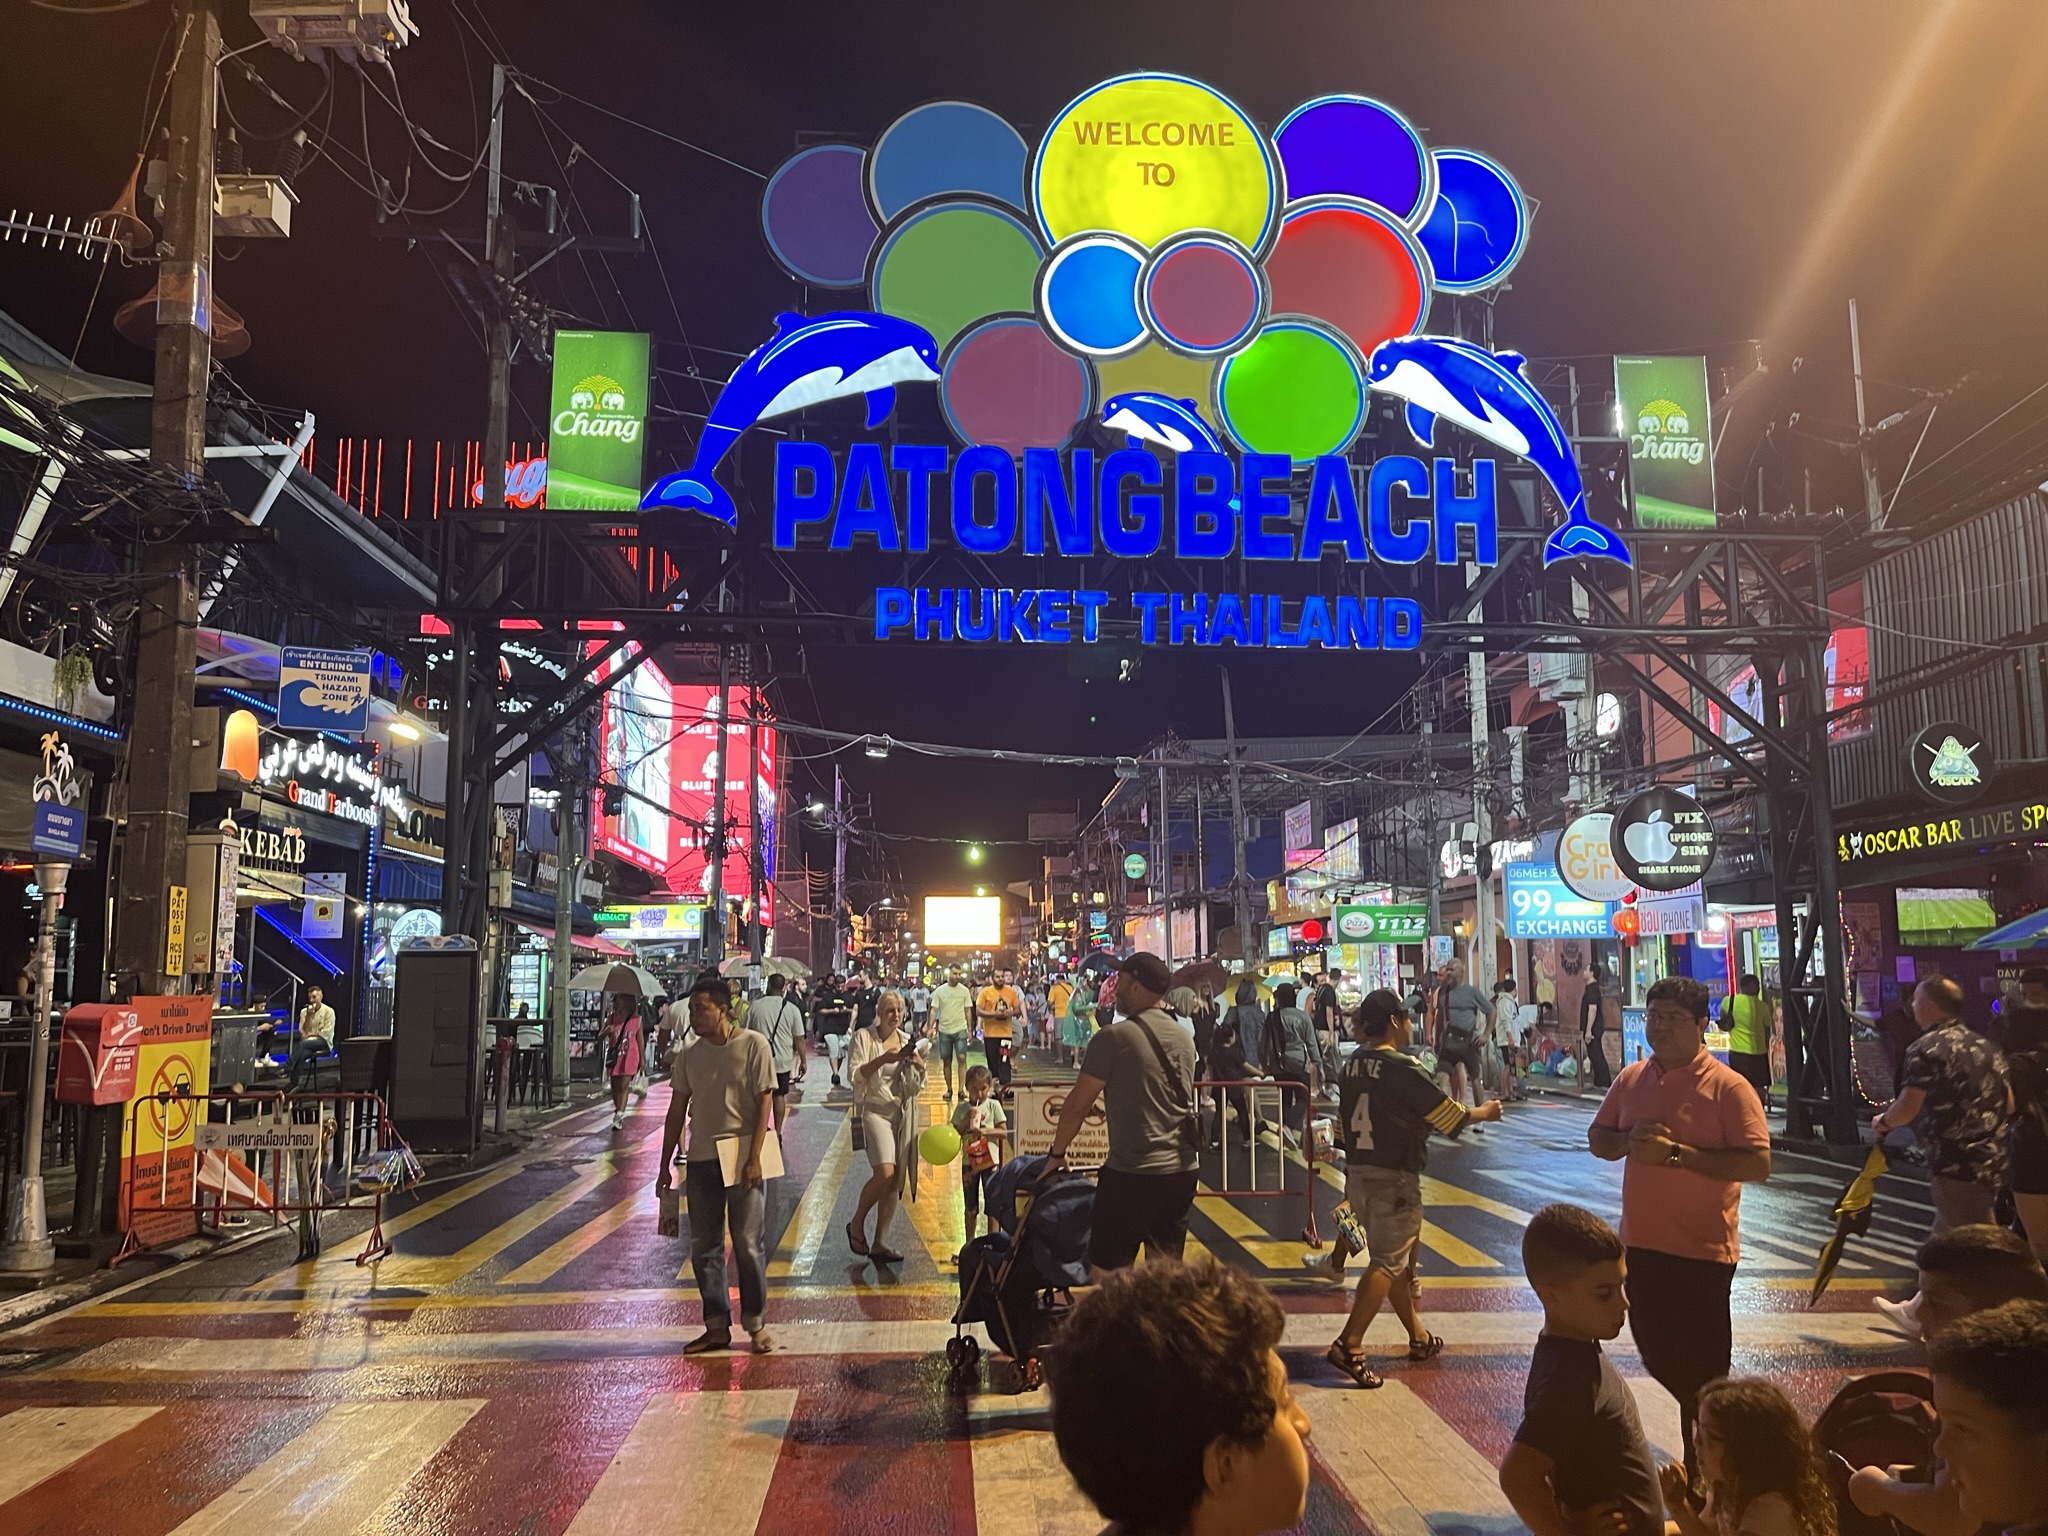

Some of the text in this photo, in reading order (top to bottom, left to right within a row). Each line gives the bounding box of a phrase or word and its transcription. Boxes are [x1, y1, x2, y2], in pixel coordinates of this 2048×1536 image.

[1073, 121, 1235, 146] WELCOME
[1136, 162, 1176, 187] TO
[553, 410, 641, 443] Chang
[773, 441, 1499, 568] PATONG BEACH
[874, 587, 1423, 651] PHUKET THAILAND
[299, 660, 353, 671] ENTERING
[314, 673, 358, 683] TSUNAMI
[322, 684, 362, 693] HAZARD
[321, 693, 349, 702] ZONE
[1937, 775, 1974, 787] OSCAR
[288, 780, 378, 826] Grand Tarboosh
[1673, 812, 1704, 824] FIX
[1864, 804, 2048, 856] OSCAR BAR LIVE SP
[1670, 832, 1713, 842] IPHONE
[240, 827, 306, 864] KEBAB
[1566, 834, 1610, 858] Cra
[1680, 845, 1709, 856] SIM
[1638, 864, 1702, 874] SHARK PHONE
[171, 898, 185, 908] PAT
[1512, 889, 1552, 916] 99
[1346, 919, 1368, 927] PIZZA
[1377, 917, 1426, 930] 1112
[1516, 919, 1607, 935] EXCHANGE
[1661, 910, 1691, 932] IPHONE
[169, 942, 182, 953] RCS
[169, 954, 182, 965] 117
[1997, 968, 2017, 978] DAY
[141, 1022, 209, 1037] on't Drive Drunk
[1350, 1093, 1375, 1150] 4
